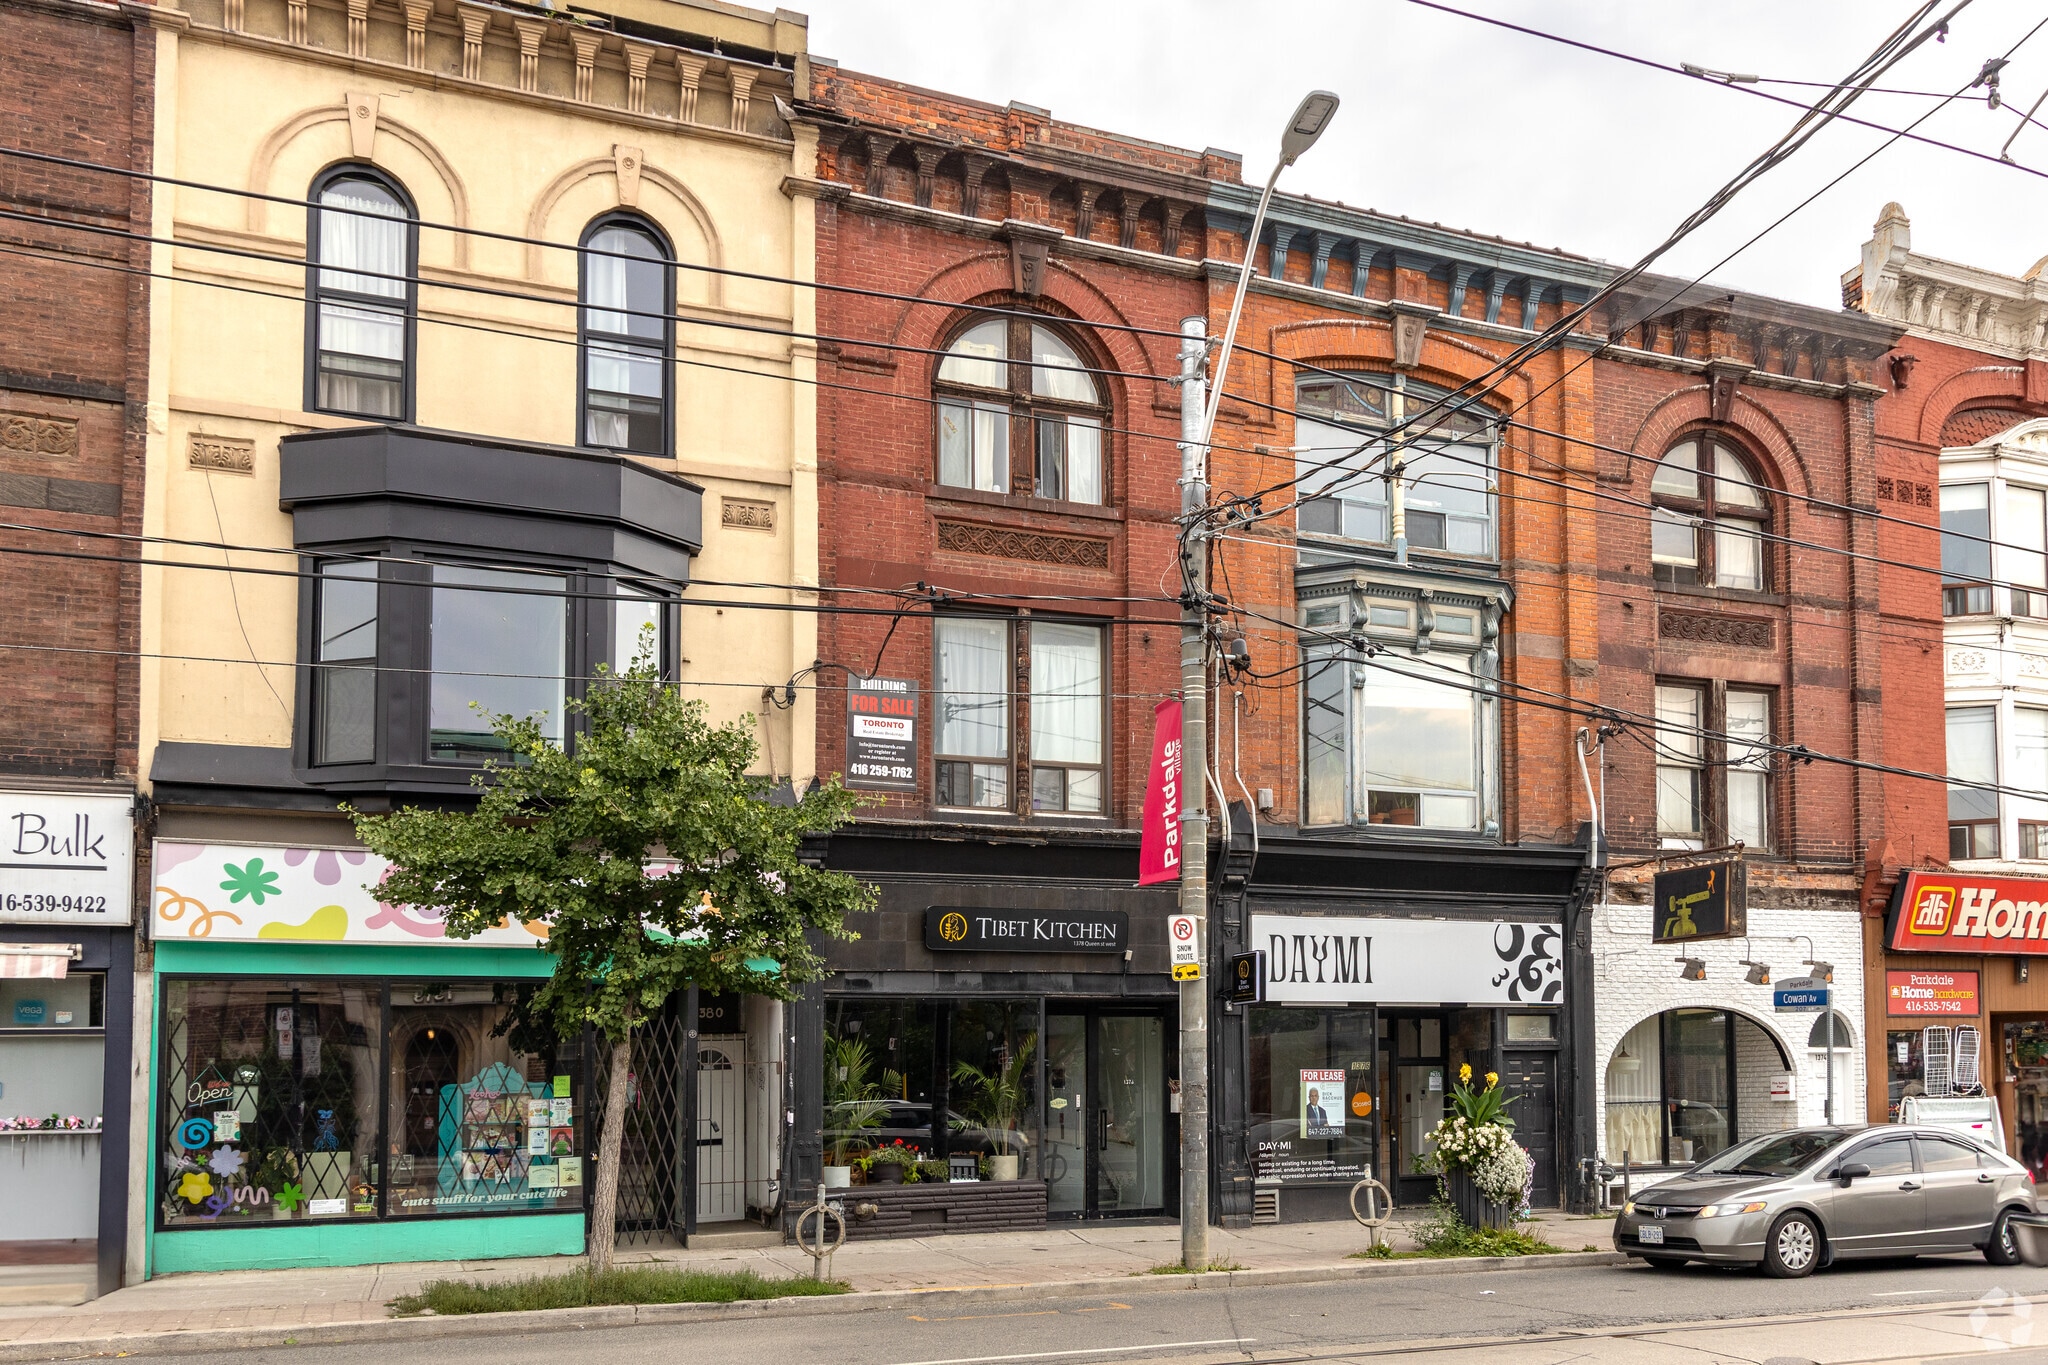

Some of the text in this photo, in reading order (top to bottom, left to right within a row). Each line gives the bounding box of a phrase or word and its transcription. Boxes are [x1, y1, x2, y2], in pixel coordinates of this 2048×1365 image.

[860, 679, 907, 693] BUILDING
[851, 694, 914, 716] FOR SALE
[862, 719, 905, 729] TORONTO
[851, 763, 913, 779] 416 259-1762
[1161, 740, 1179, 869] Parkdale
[11, 812, 106, 860] Bulk
[976, 917, 1117, 940] TIBET KITCHEN
[1176, 944, 1192, 952] SNOW
[1176, 953, 1194, 961] ROUTE
[1268, 934, 1373, 983] DAYMI
[1790, 980, 1813, 989] Parkdale
[1910, 974, 1954, 985] Parkdale
[1783, 993, 1817, 1004] Cowan Av
[1901, 985, 1974, 999] Home hardware
[1905, 1001, 1962, 1011] 416-535-7542
[1303, 1071, 1343, 1081] FOR LEASE
[188, 1082, 233, 1107] Open
[401, 1187, 568, 1207] cute stuff for your cute life
